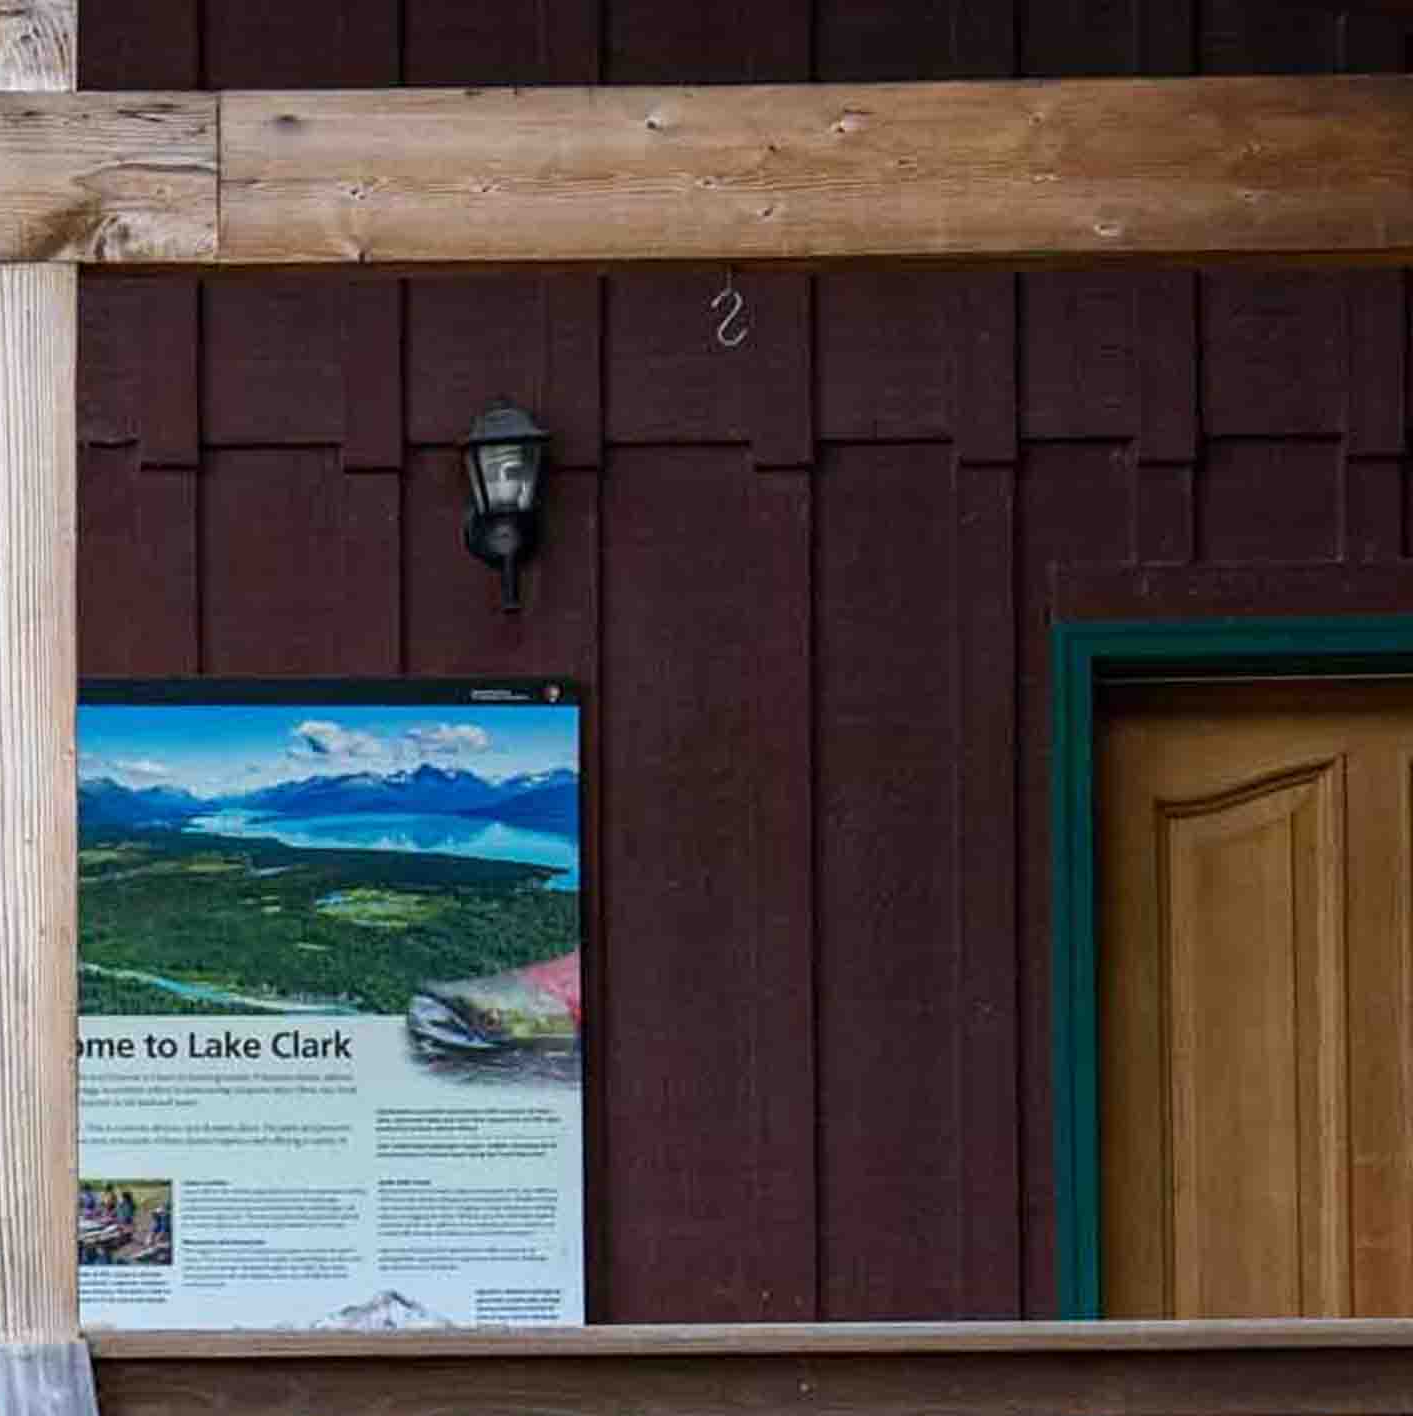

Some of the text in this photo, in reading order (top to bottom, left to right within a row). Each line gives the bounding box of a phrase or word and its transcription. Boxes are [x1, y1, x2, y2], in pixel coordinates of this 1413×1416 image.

[144, 1034, 178, 1059] to
[188, 1031, 262, 1059] Lake
[271, 1030, 353, 1059] Clark
